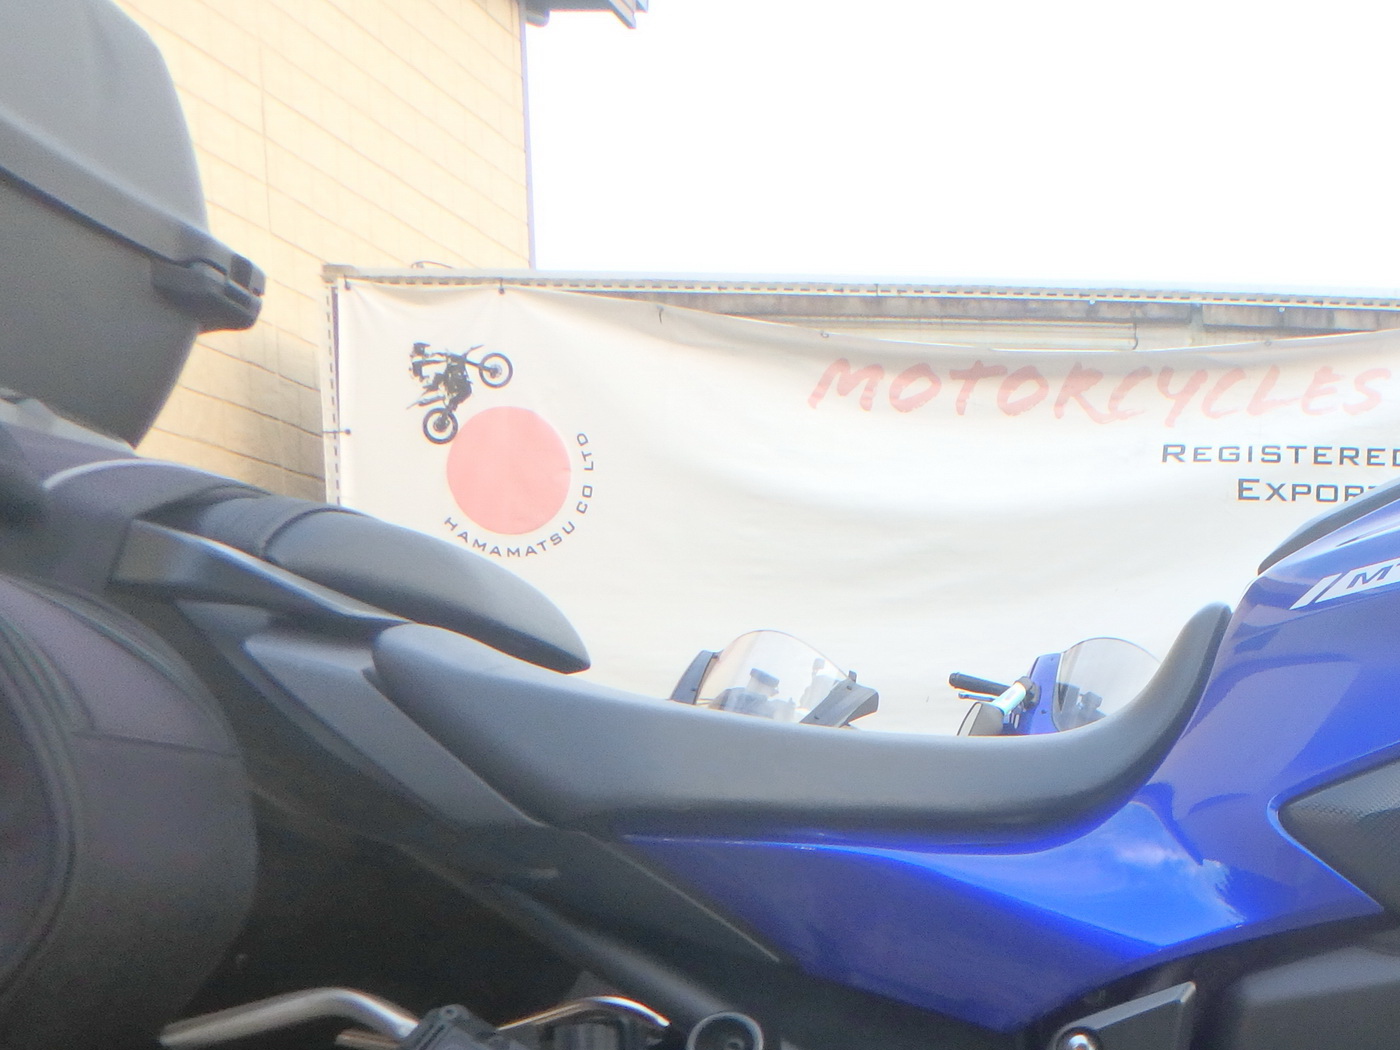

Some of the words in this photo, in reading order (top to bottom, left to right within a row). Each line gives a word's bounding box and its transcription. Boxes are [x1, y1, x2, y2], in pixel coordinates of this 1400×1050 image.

[807, 358, 1392, 427] MOTORCYCLES
[576, 432, 594, 471] LTD
[576, 485, 593, 514] CO
[1237, 477, 1380, 503] EXPOR
[444, 517, 576, 558] HAMAMATSU
